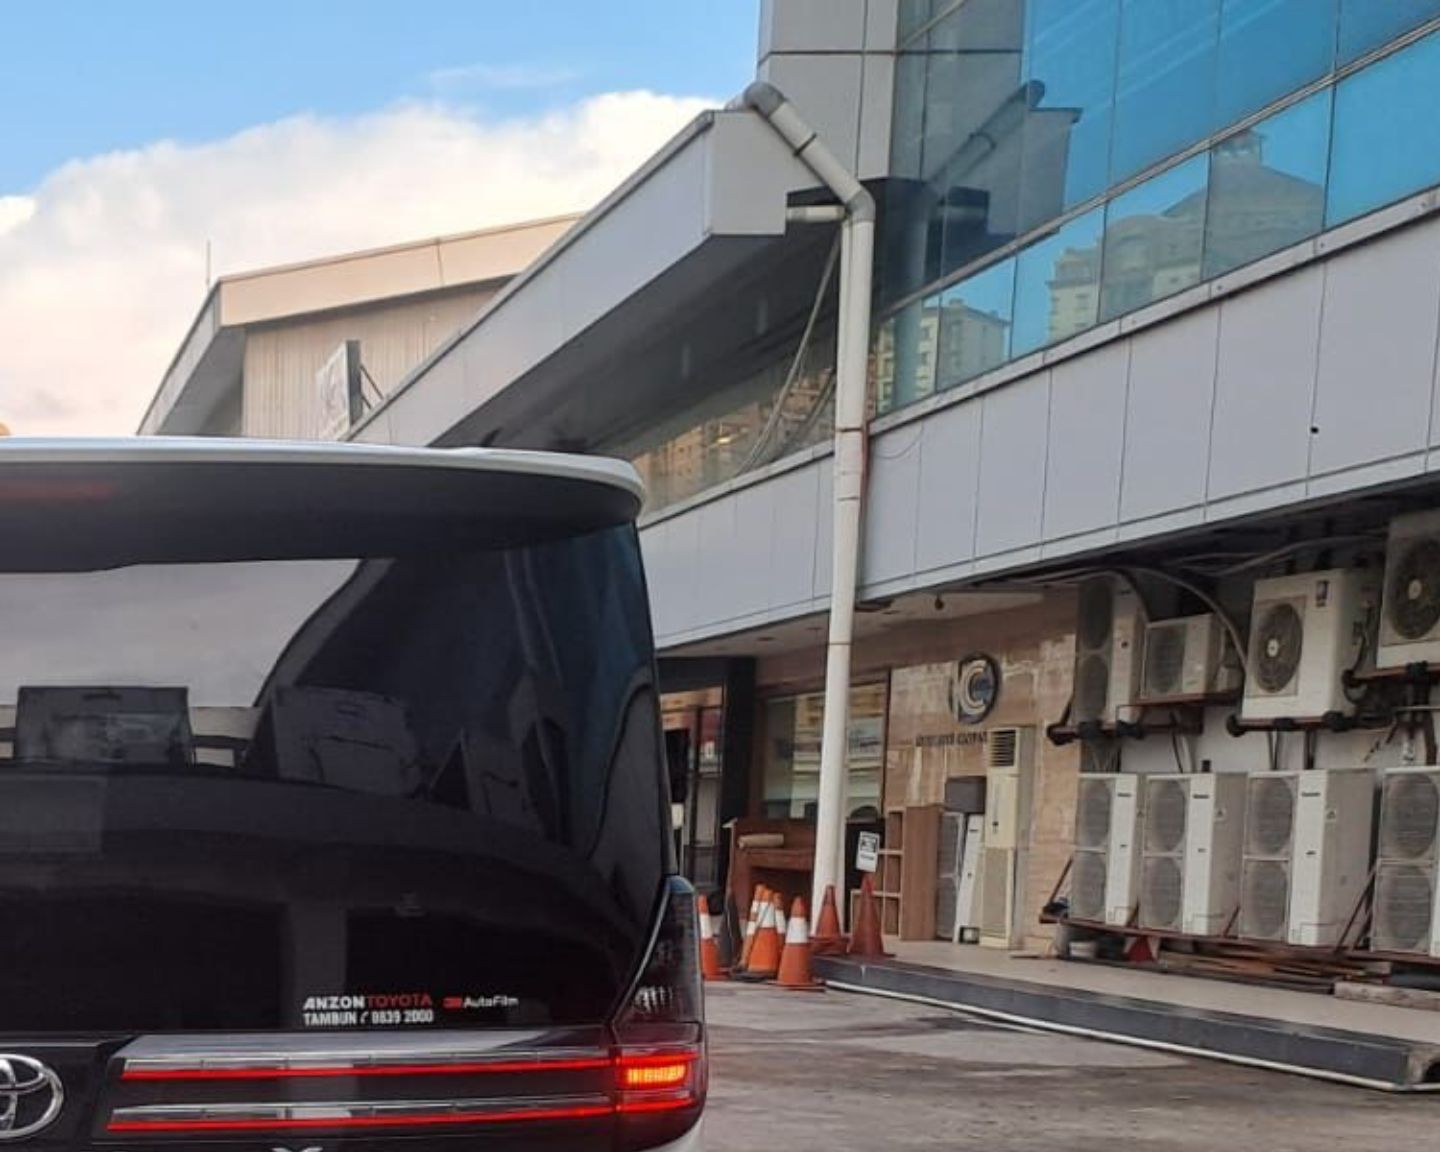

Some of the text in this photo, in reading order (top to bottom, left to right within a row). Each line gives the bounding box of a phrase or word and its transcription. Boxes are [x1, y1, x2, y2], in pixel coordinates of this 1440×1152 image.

[302, 995, 365, 1011] ANZON
[367, 992, 433, 1009] TOYOTA
[303, 1011, 358, 1027] TAMBUN
